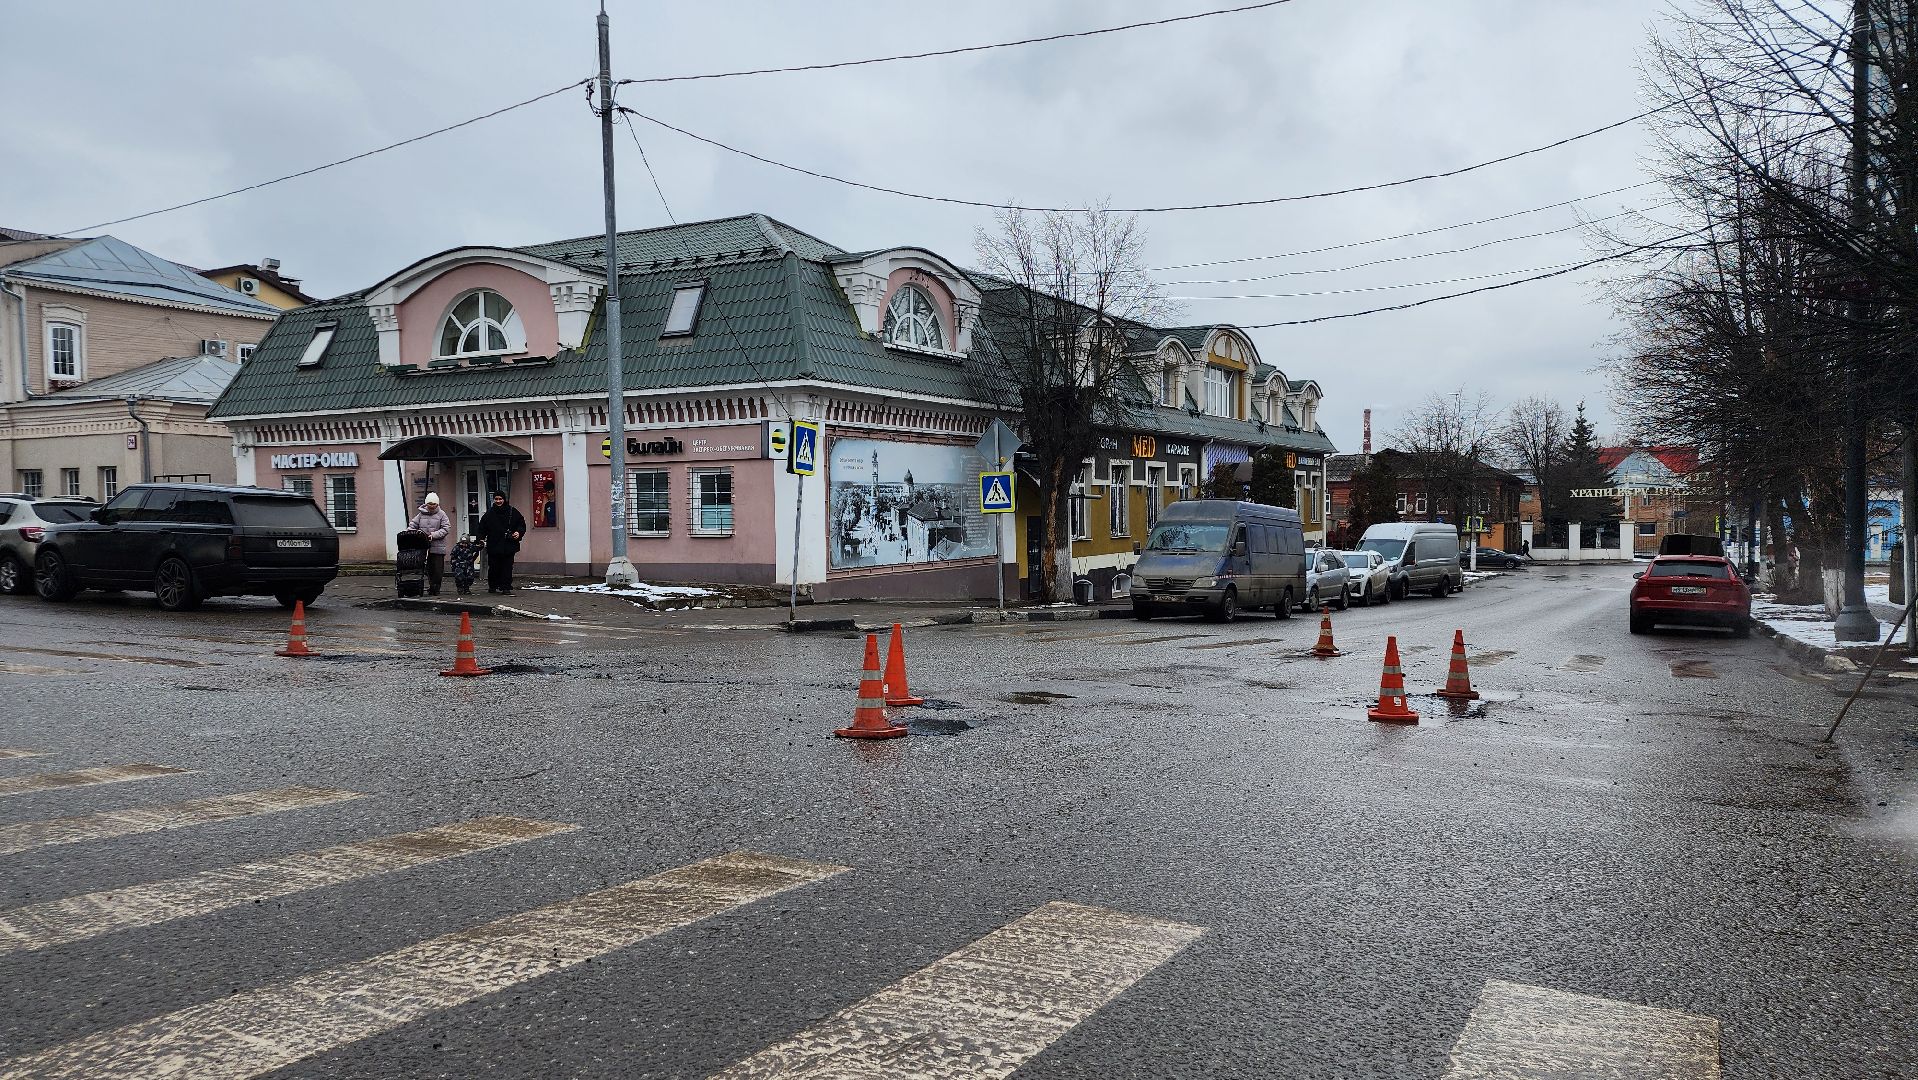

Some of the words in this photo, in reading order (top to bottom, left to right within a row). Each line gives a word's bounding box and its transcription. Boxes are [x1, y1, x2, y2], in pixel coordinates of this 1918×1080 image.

[1165, 443, 1190, 456] КАРАОКЕ
[270, 452, 359, 469] МАСТЕР-ОКНА
[1569, 487, 1613, 498] ХРАНИ
